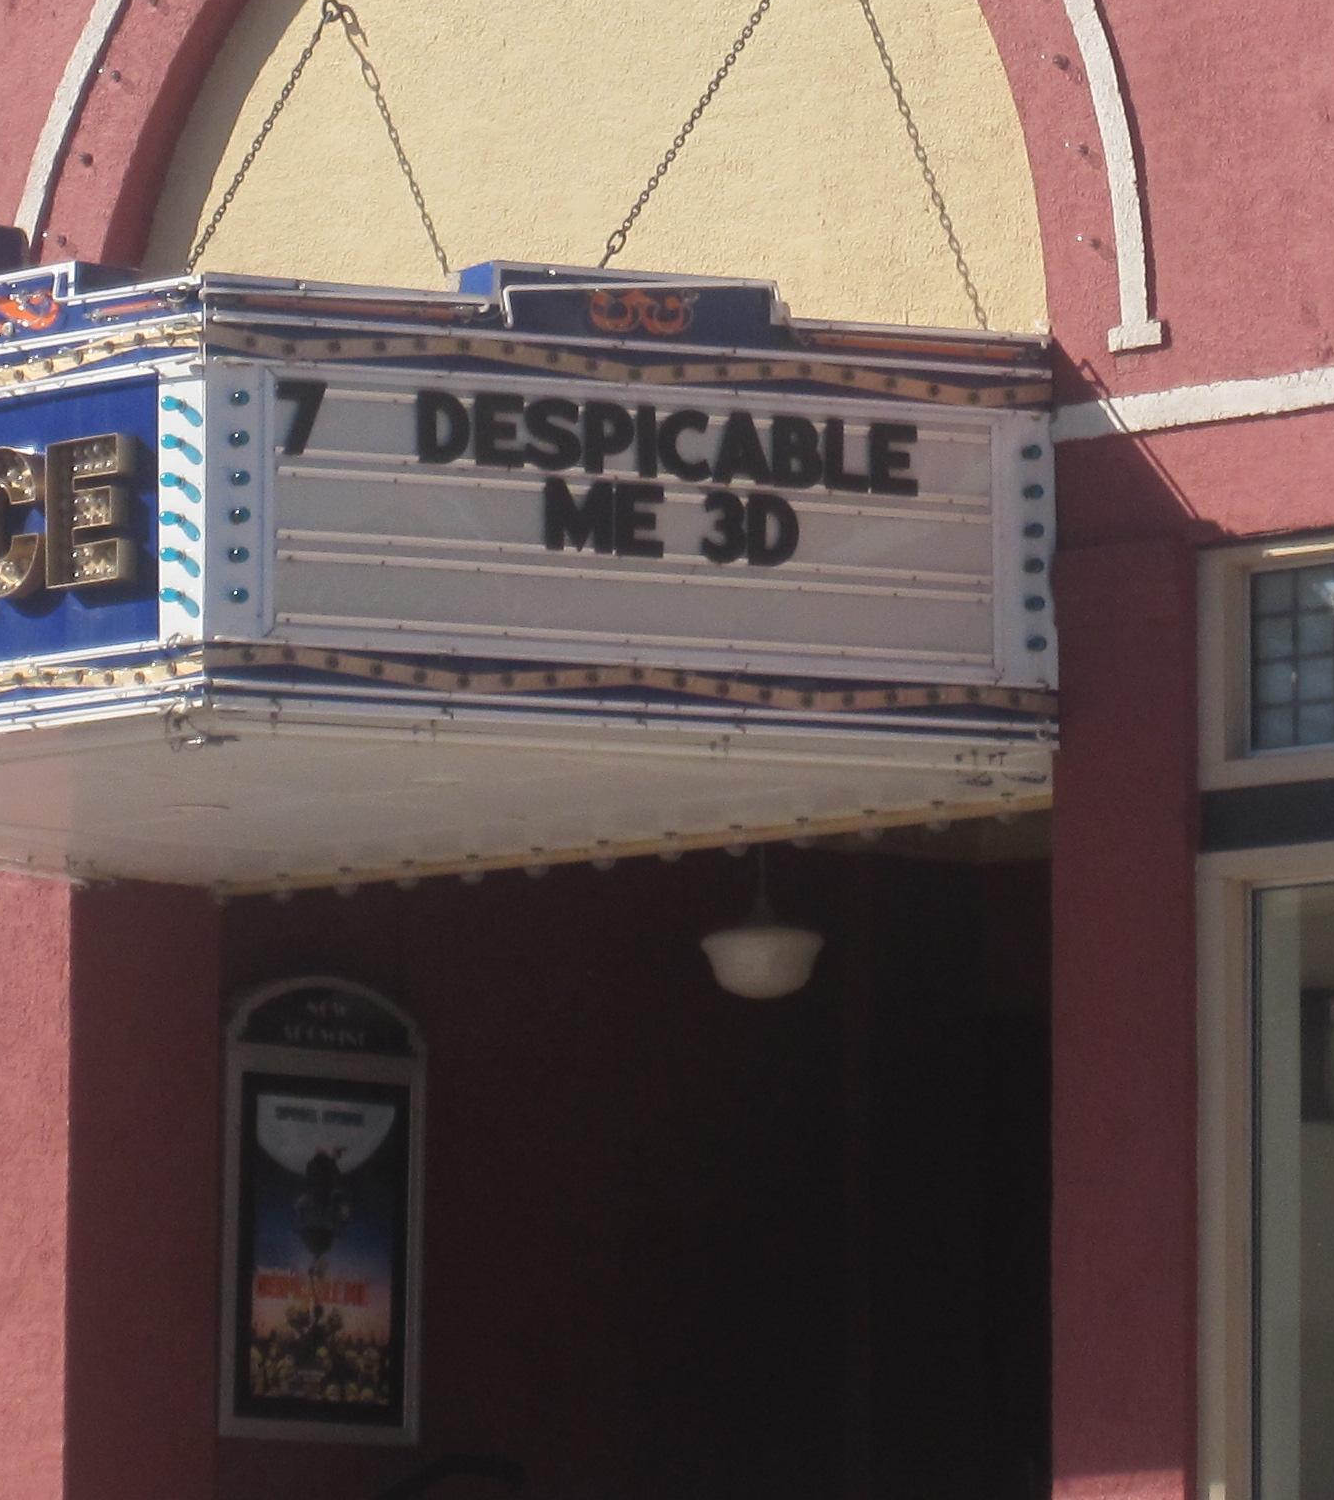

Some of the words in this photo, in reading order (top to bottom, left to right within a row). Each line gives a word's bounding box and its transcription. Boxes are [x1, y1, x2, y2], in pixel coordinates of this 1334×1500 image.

[274, 381, 328, 455] 7
[415, 389, 919, 498] DESPICABLE
[542, 476, 665, 559] ME
[700, 487, 800, 567] 3D
